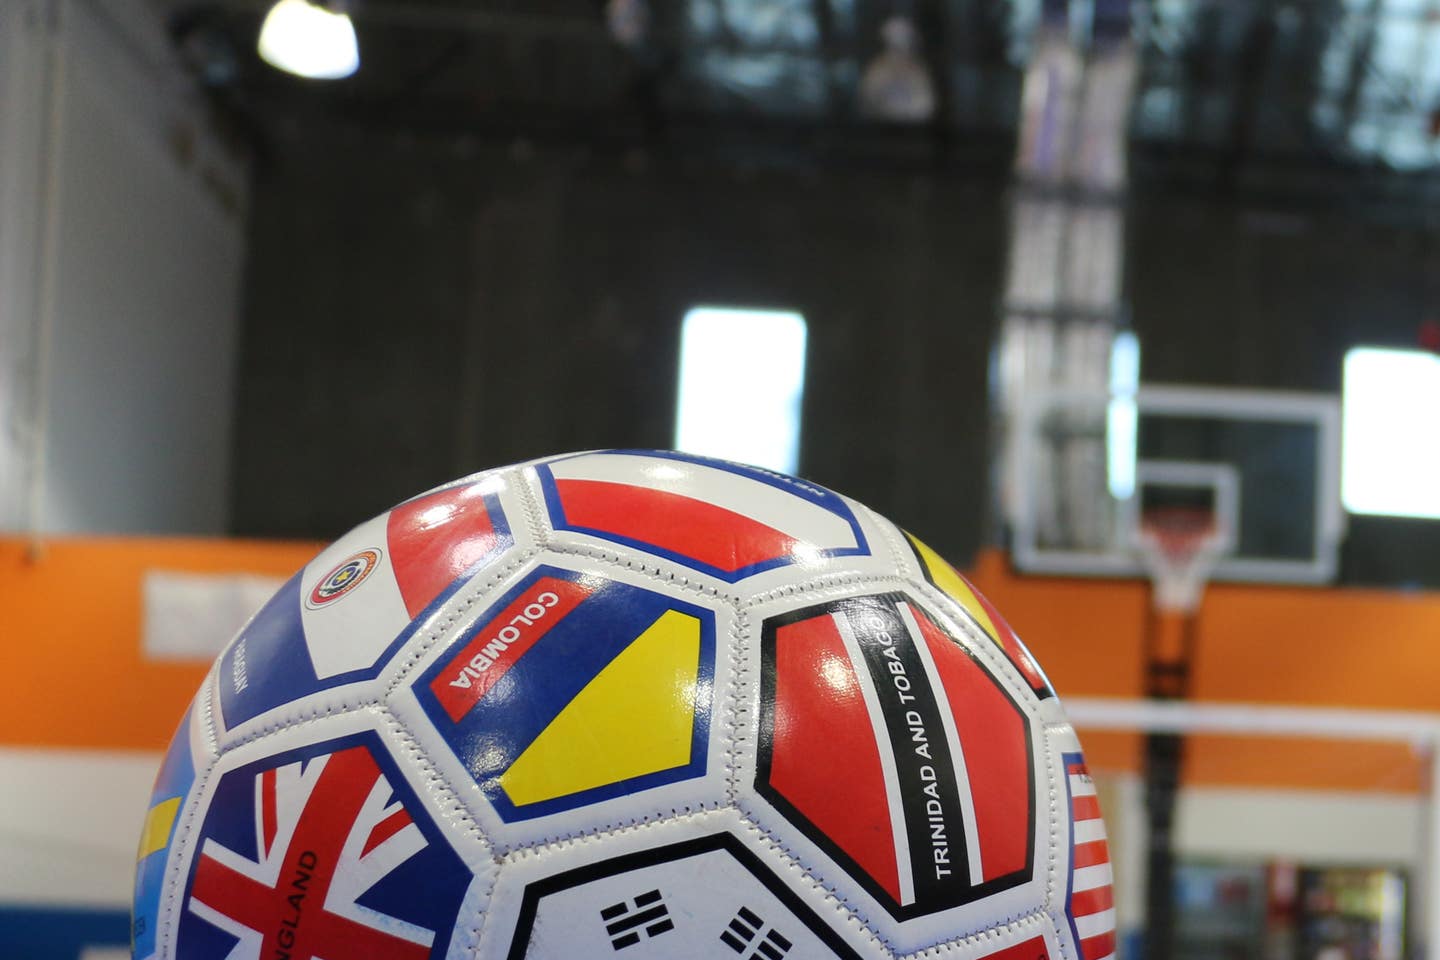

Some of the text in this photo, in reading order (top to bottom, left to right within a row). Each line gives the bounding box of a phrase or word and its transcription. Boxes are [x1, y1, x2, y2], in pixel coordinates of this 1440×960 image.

[449, 592, 559, 689] COLOMBIA
[870, 616, 952, 880] TRINIDAD AND TOBAGO
